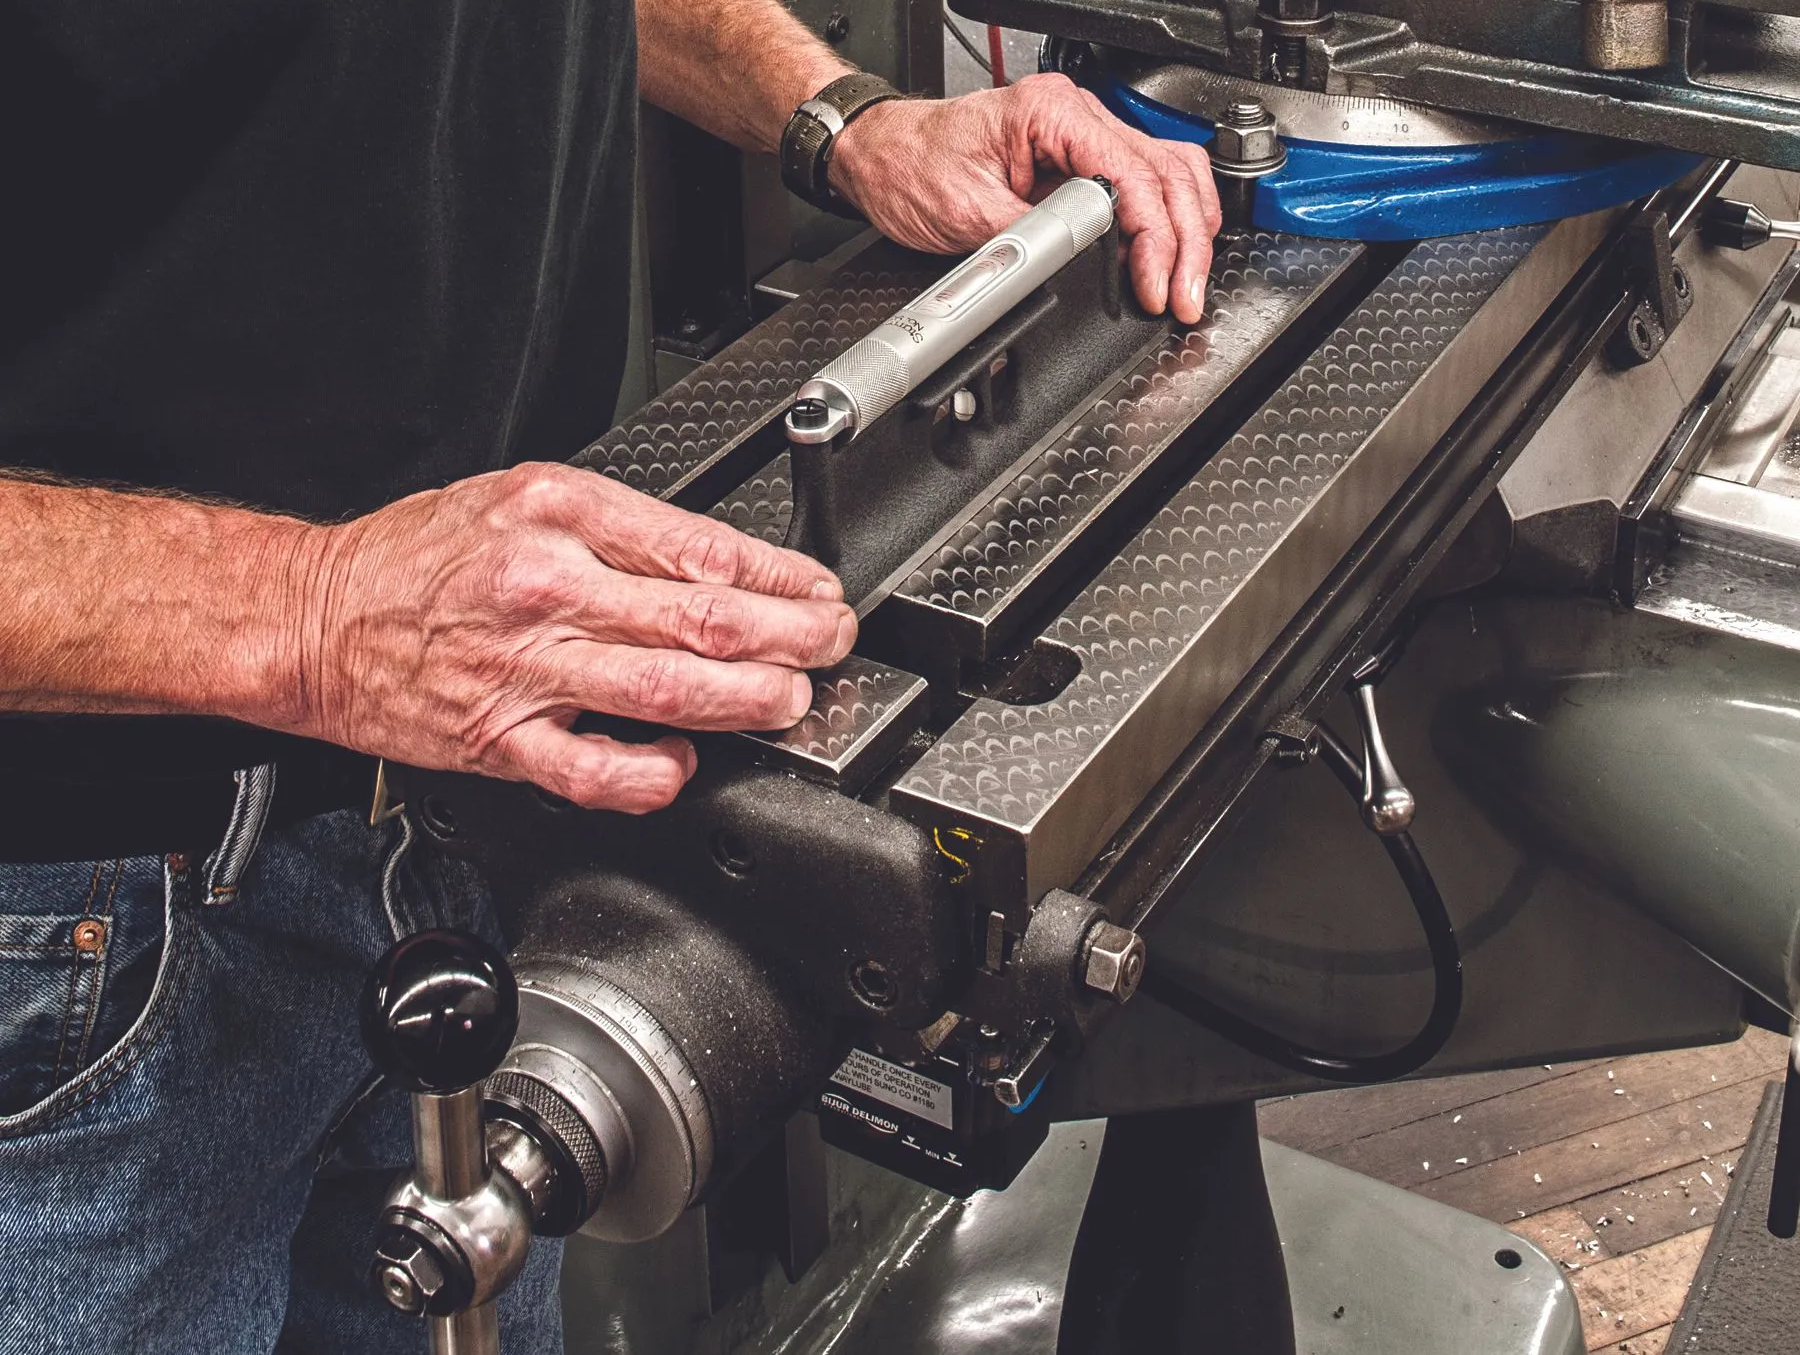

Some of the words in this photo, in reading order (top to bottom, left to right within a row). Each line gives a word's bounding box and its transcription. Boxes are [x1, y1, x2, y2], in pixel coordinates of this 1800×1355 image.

[1342, 121, 1350, 132] 0
[1394, 123, 1409, 134] 10
[618, 1016, 638, 1036] 190
[651, 1049, 670, 1072] 180
[855, 1053, 888, 1072] HANDLE
[889, 1066, 913, 1082] ONCE
[914, 1076, 942, 1094] EVERY
[871, 1067, 882, 1078] OF
[852, 1070, 873, 1085] WITH
[874, 1079, 898, 1094] SUNO
[899, 1088, 912, 1100] CO
[822, 1094, 850, 1113] BIJUR
[852, 1107, 899, 1133] DELIMON
[925, 1149, 940, 1160] MIN
